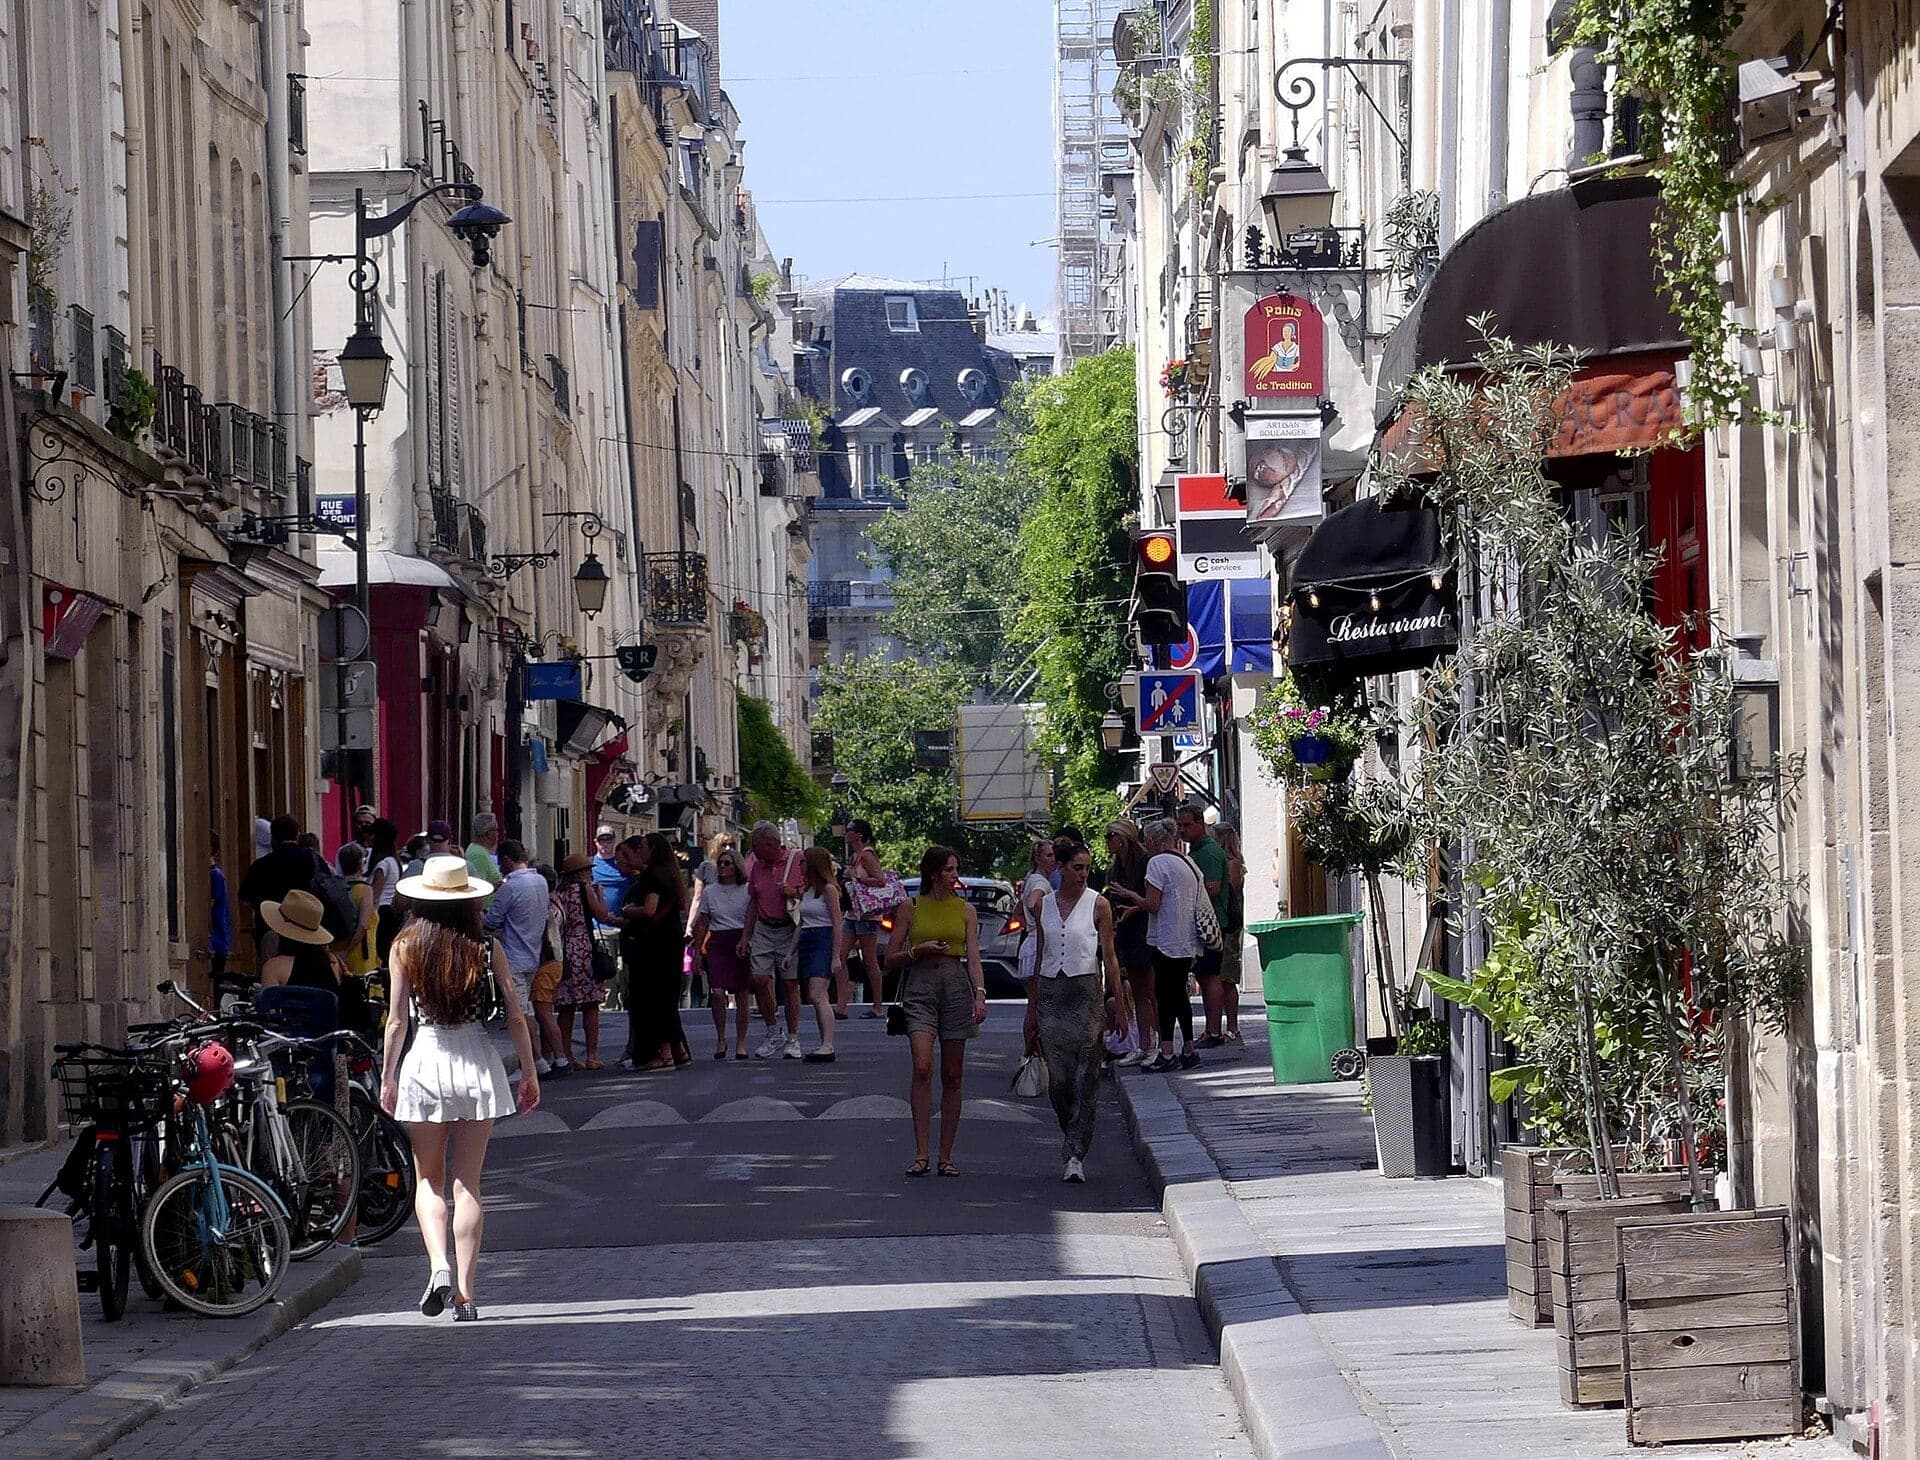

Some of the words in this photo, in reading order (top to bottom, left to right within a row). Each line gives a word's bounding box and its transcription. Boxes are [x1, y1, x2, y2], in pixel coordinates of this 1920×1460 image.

[1264, 305, 1303, 318] Pains
[1256, 381, 1268, 391] de
[1269, 381, 1313, 391] Tradition
[1558, 388, 1681, 434] AURA
[1265, 421, 1300, 429] ARTISAN
[1259, 428, 1307, 437] BOULANGER
[320, 501, 343, 509] RUE
[331, 514, 356, 523] PONT
[1210, 556, 1230, 564] cash
[1326, 606, 1452, 643] Restaurant
